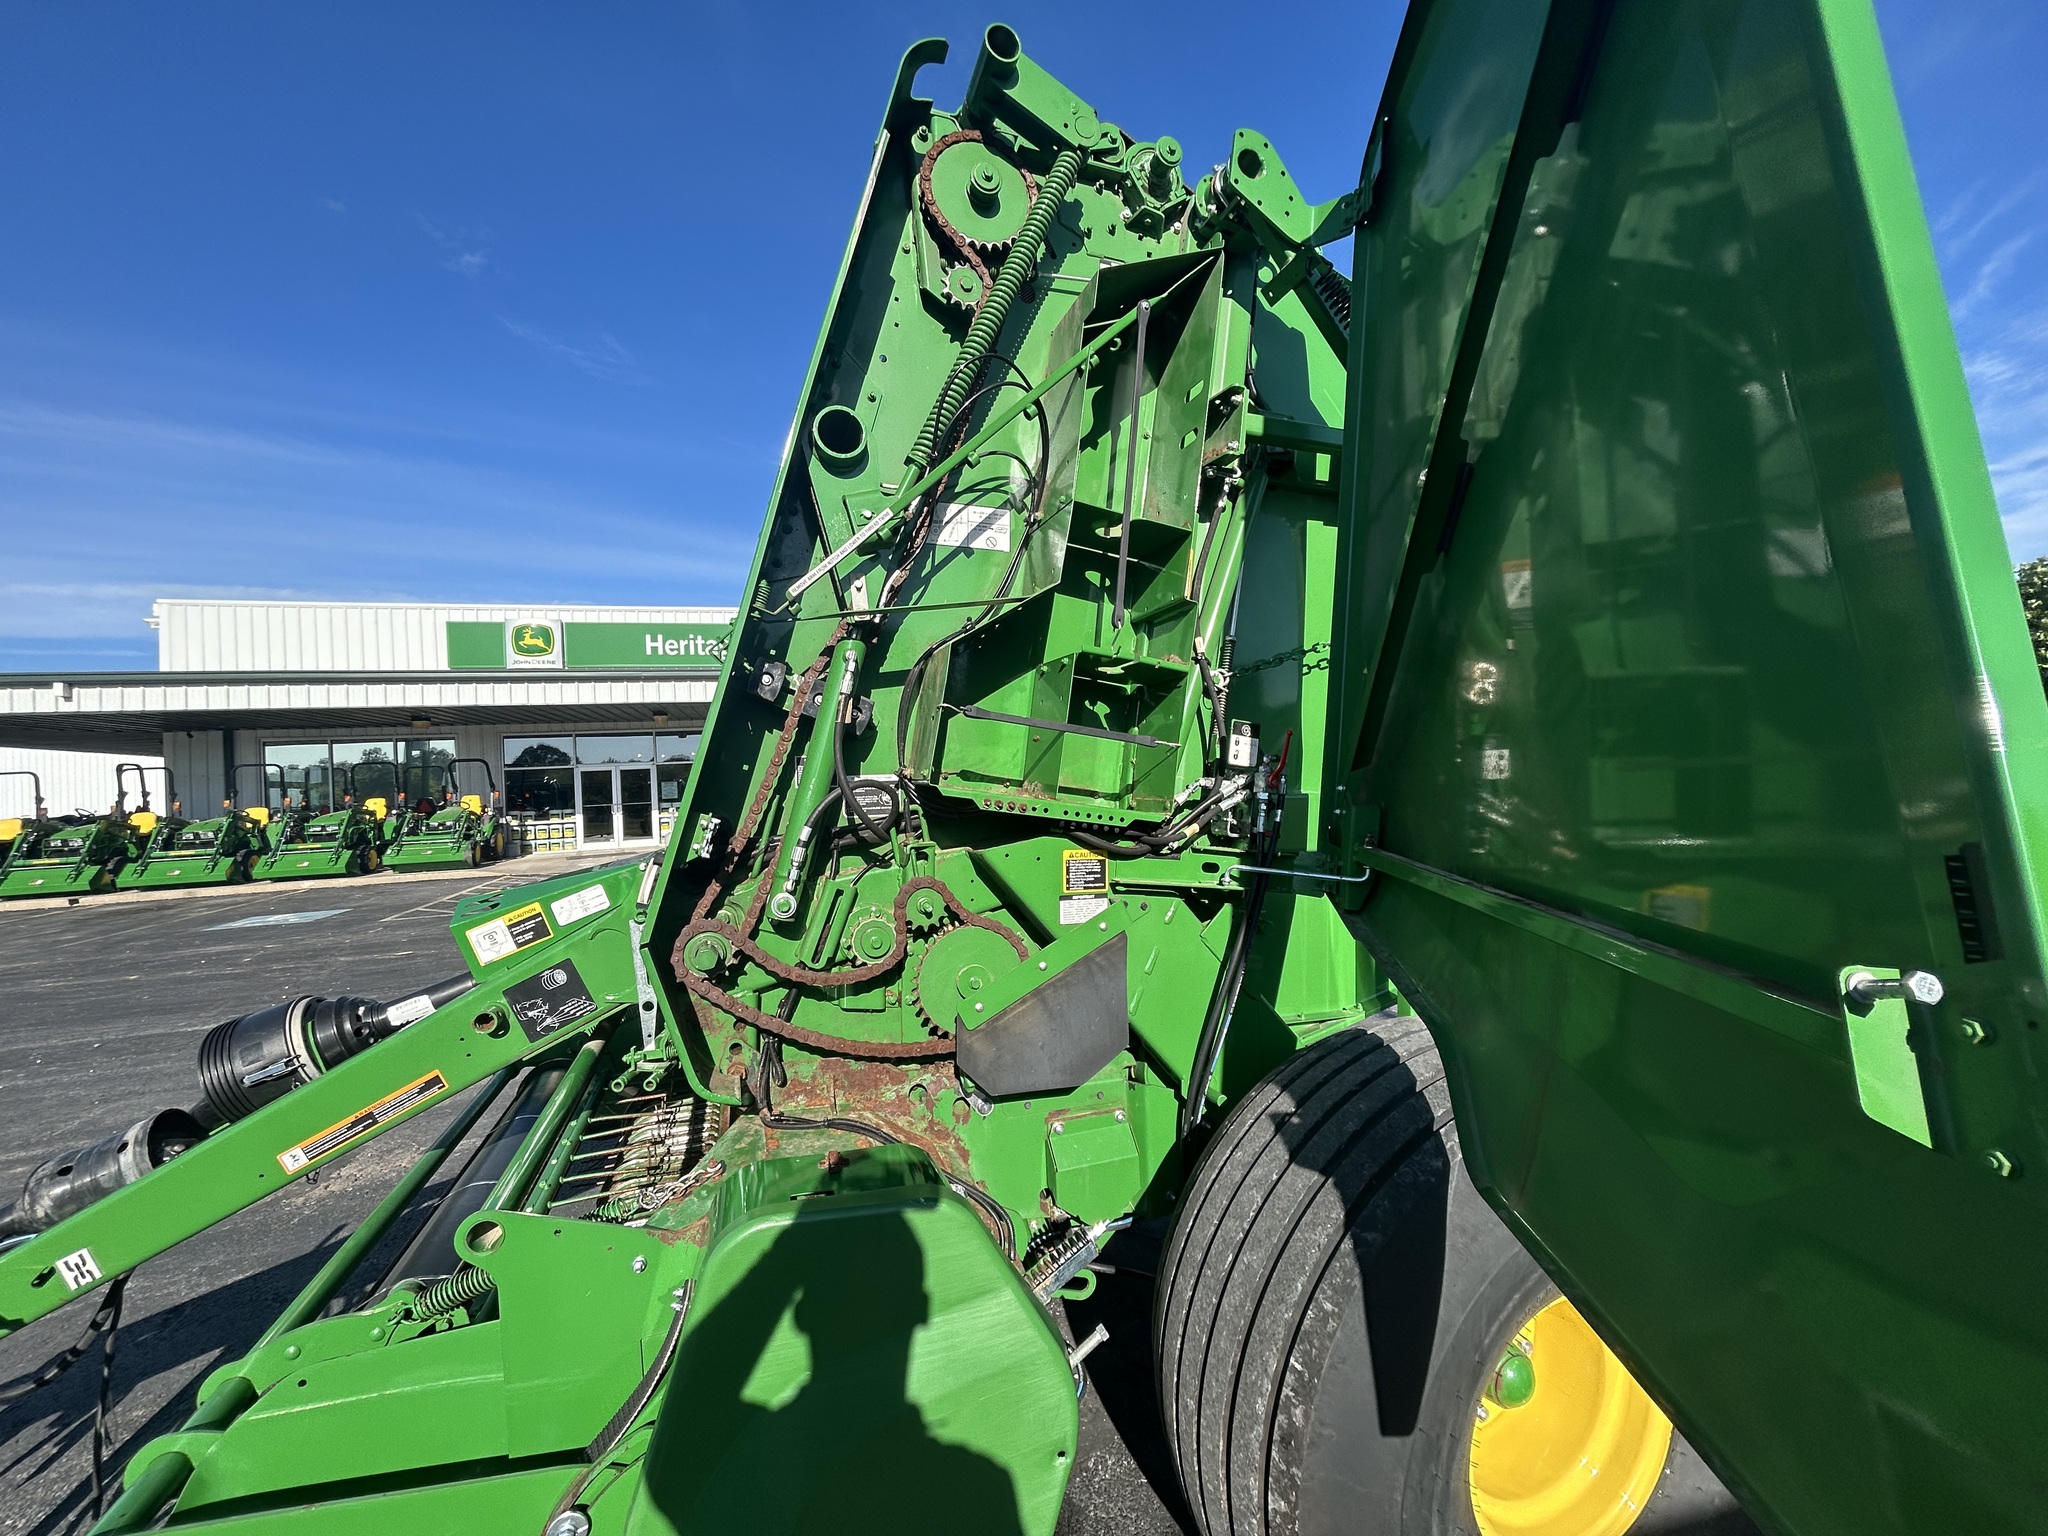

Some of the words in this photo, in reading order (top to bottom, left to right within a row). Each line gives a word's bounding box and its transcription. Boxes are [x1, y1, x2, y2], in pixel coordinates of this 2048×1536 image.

[790, 578, 808, 594] REMOVE
[806, 571, 817, 581] ARM
[814, 562, 828, 574] FROM
[825, 552, 840, 565] NOTCH
[838, 545, 848, 555] AND
[846, 535, 861, 548] LOWER
[859, 530, 866, 538] TO
[864, 519, 880, 534] THREAD
[878, 510, 891, 522] TWINE
[513, 907, 537, 920] CAUTION
